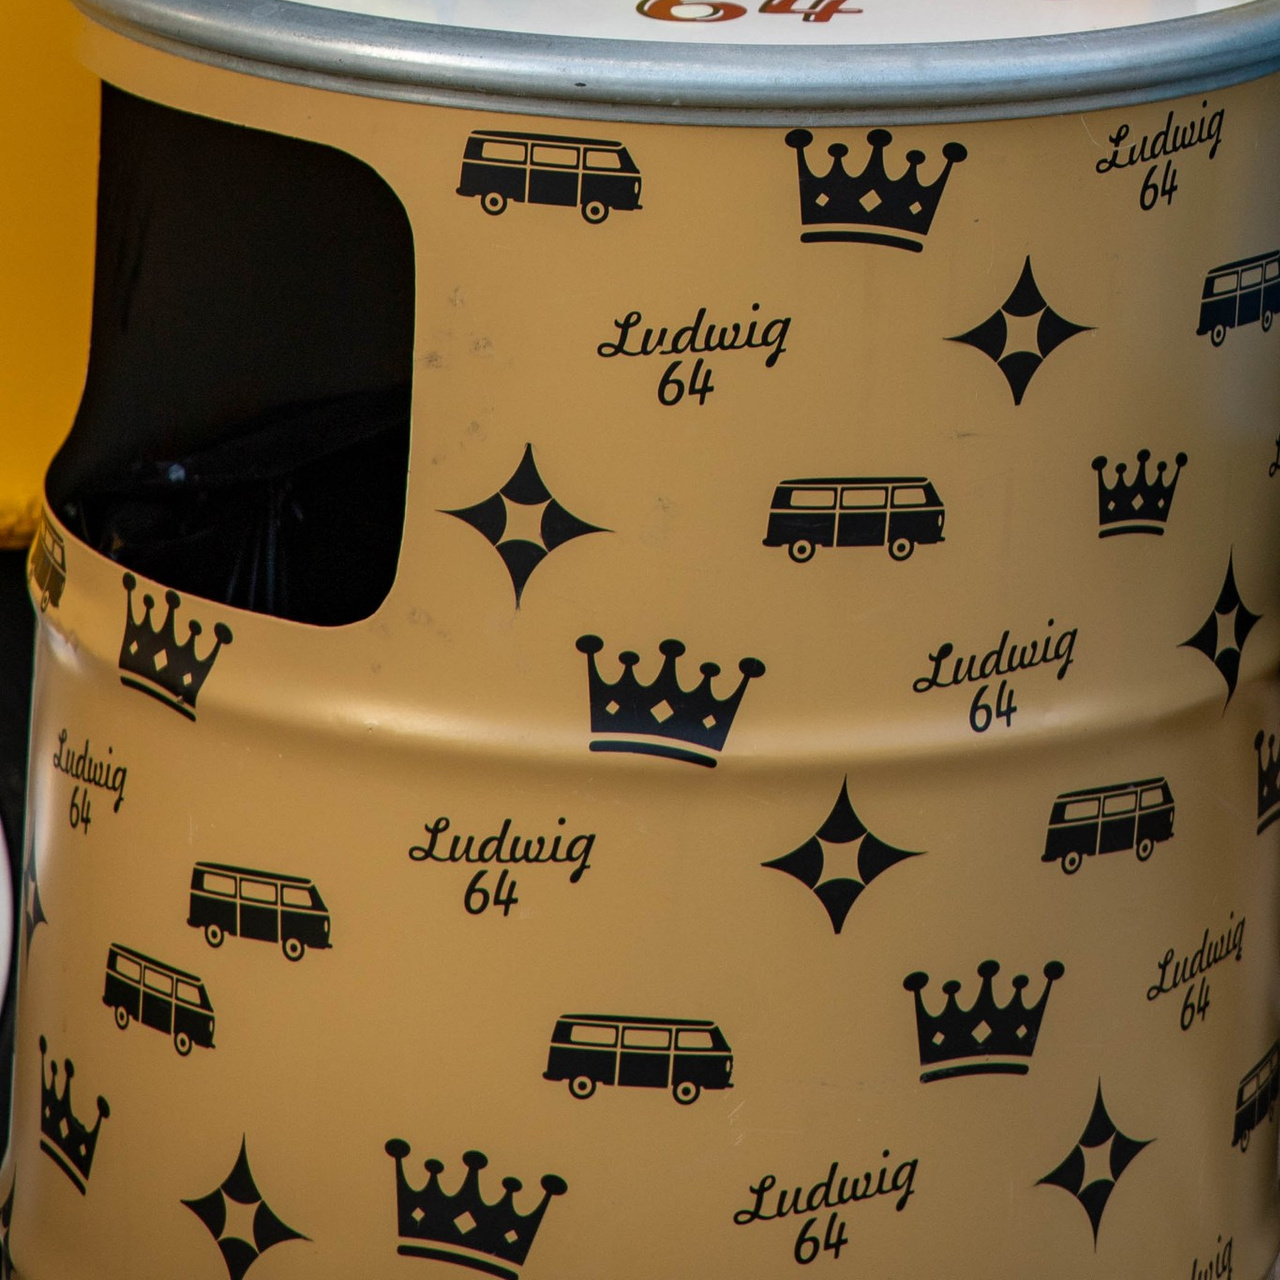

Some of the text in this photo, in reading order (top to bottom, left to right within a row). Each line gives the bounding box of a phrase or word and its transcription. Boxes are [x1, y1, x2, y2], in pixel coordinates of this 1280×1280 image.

[1095, 100, 1226, 173] Ludwig
[1139, 164, 1179, 212] 64
[597, 302, 792, 368] Ludwig
[657, 358, 715, 407] 64
[912, 618, 1079, 694] Ludwig
[969, 680, 1018, 733] 64
[53, 728, 128, 813] Ludwig
[69, 786, 92, 835] 64
[408, 816, 597, 884] Ludwig
[463, 869, 519, 917] 64
[1146, 911, 1246, 1002] Ludwig
[1180, 976, 1211, 1032] 64
[732, 1149, 919, 1226] Ludwig
[793, 1212, 849, 1266] 64
